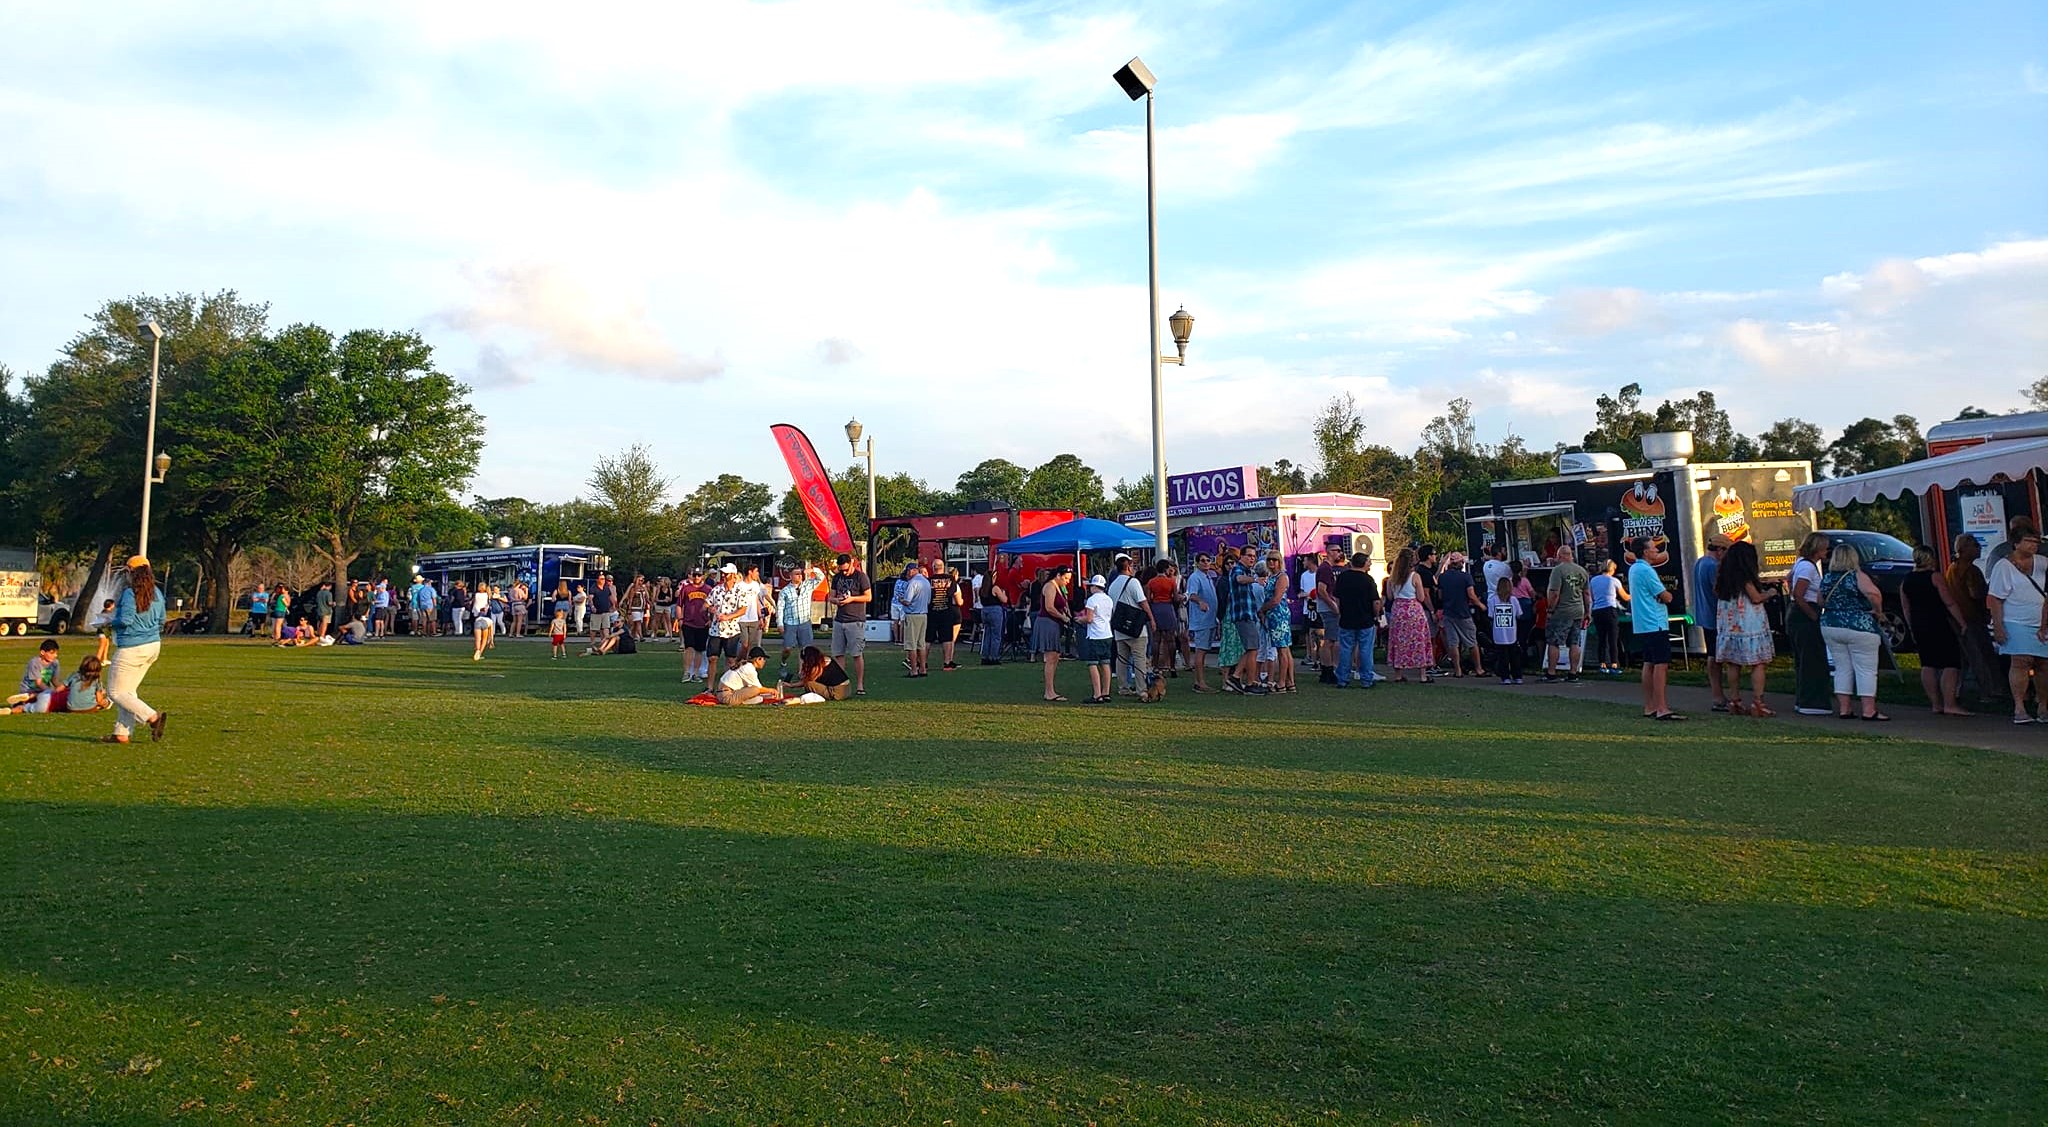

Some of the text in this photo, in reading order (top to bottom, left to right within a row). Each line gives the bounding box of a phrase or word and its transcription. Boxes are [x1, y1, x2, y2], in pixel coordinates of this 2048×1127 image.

[1172, 471, 1239, 502] TACOS
[1624, 517, 1662, 527] BETWEEN
[1721, 518, 1744, 533] BUNZ
[1627, 526, 1663, 538] BUNZ
[24, 579, 39, 588] ICE
[1496, 615, 1512, 627] OBEY
